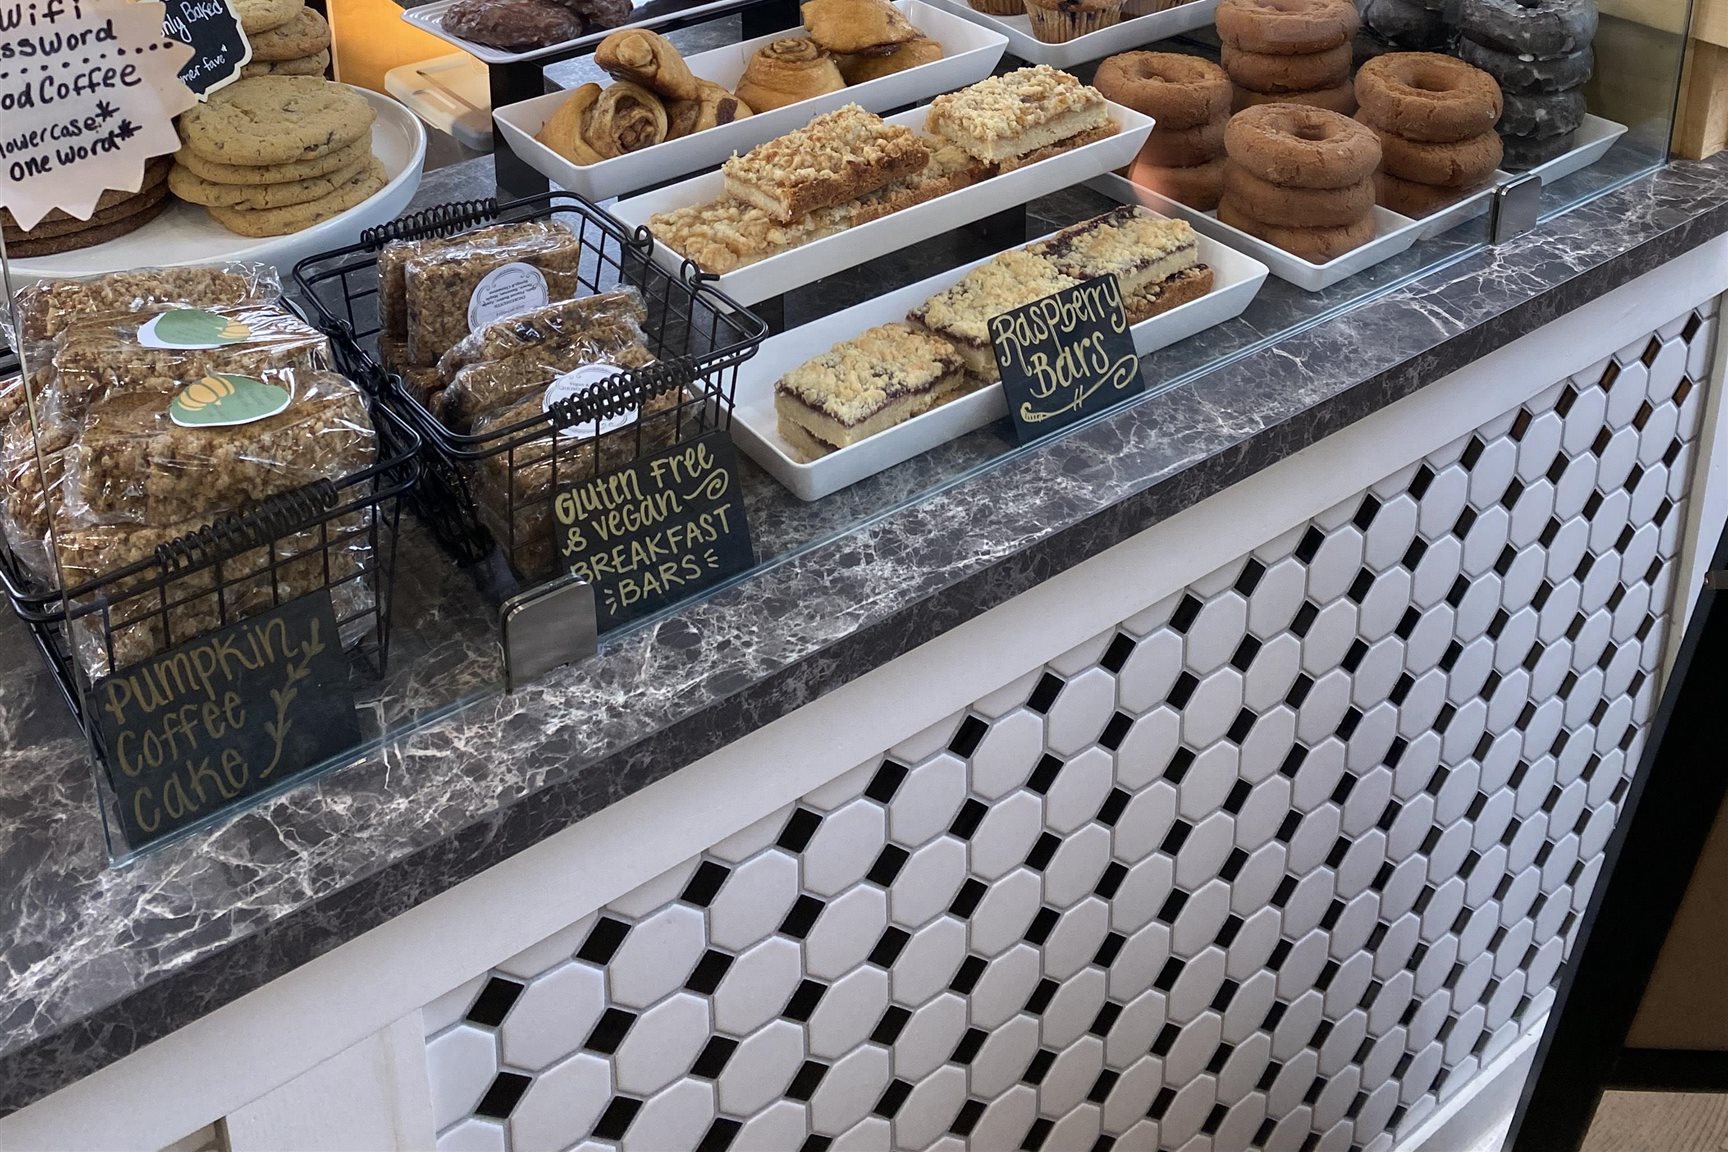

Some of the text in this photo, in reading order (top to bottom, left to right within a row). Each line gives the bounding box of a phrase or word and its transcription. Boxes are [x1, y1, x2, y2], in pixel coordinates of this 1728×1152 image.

[202, 54, 226, 72] fave
[992, 276, 1127, 377] Raspberry
[1030, 331, 1109, 399] Bars
[555, 442, 714, 525] Gluten Free
[562, 527, 587, 557] &
[570, 504, 731, 584] BREAKFAST
[619, 555, 702, 607] BARS
